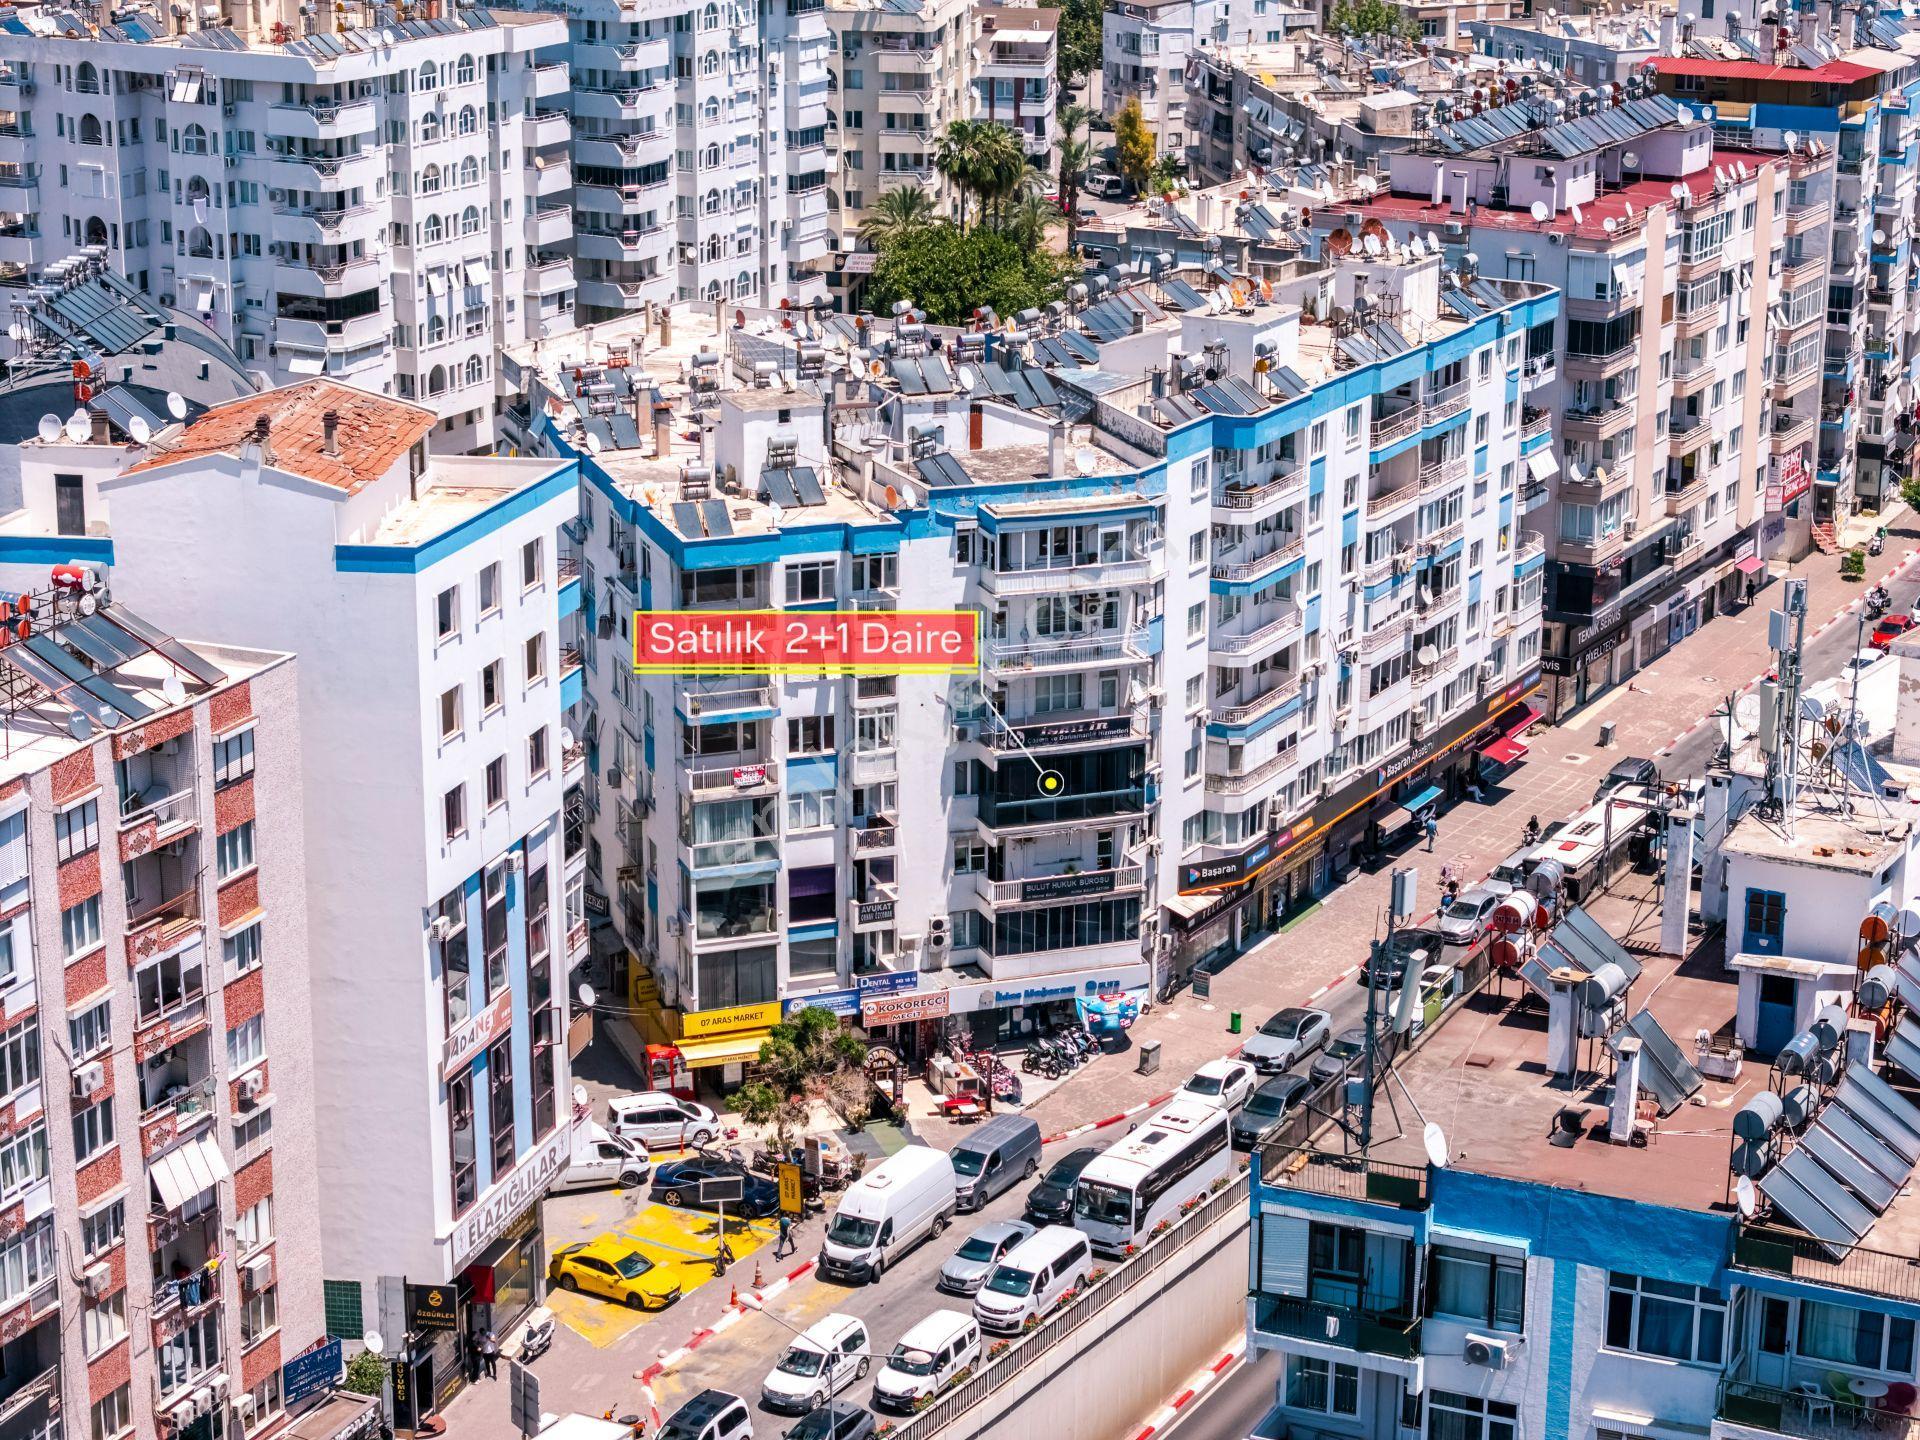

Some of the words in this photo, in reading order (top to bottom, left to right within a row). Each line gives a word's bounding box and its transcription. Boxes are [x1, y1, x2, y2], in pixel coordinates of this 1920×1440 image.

[1386, 756, 1411, 778] Başaran
[1201, 864, 1237, 878] Başaran
[861, 903, 892, 913] AVUKAT
[860, 978, 891, 988] DENTAL
[700, 1018, 711, 1027] 07
[712, 1016, 732, 1026] ARAS
[733, 1012, 764, 1022] MARKET
[468, 1146, 557, 1247] ELAZIĞLILAR
[417, 1309, 455, 1319] ÖZGÜRLER
